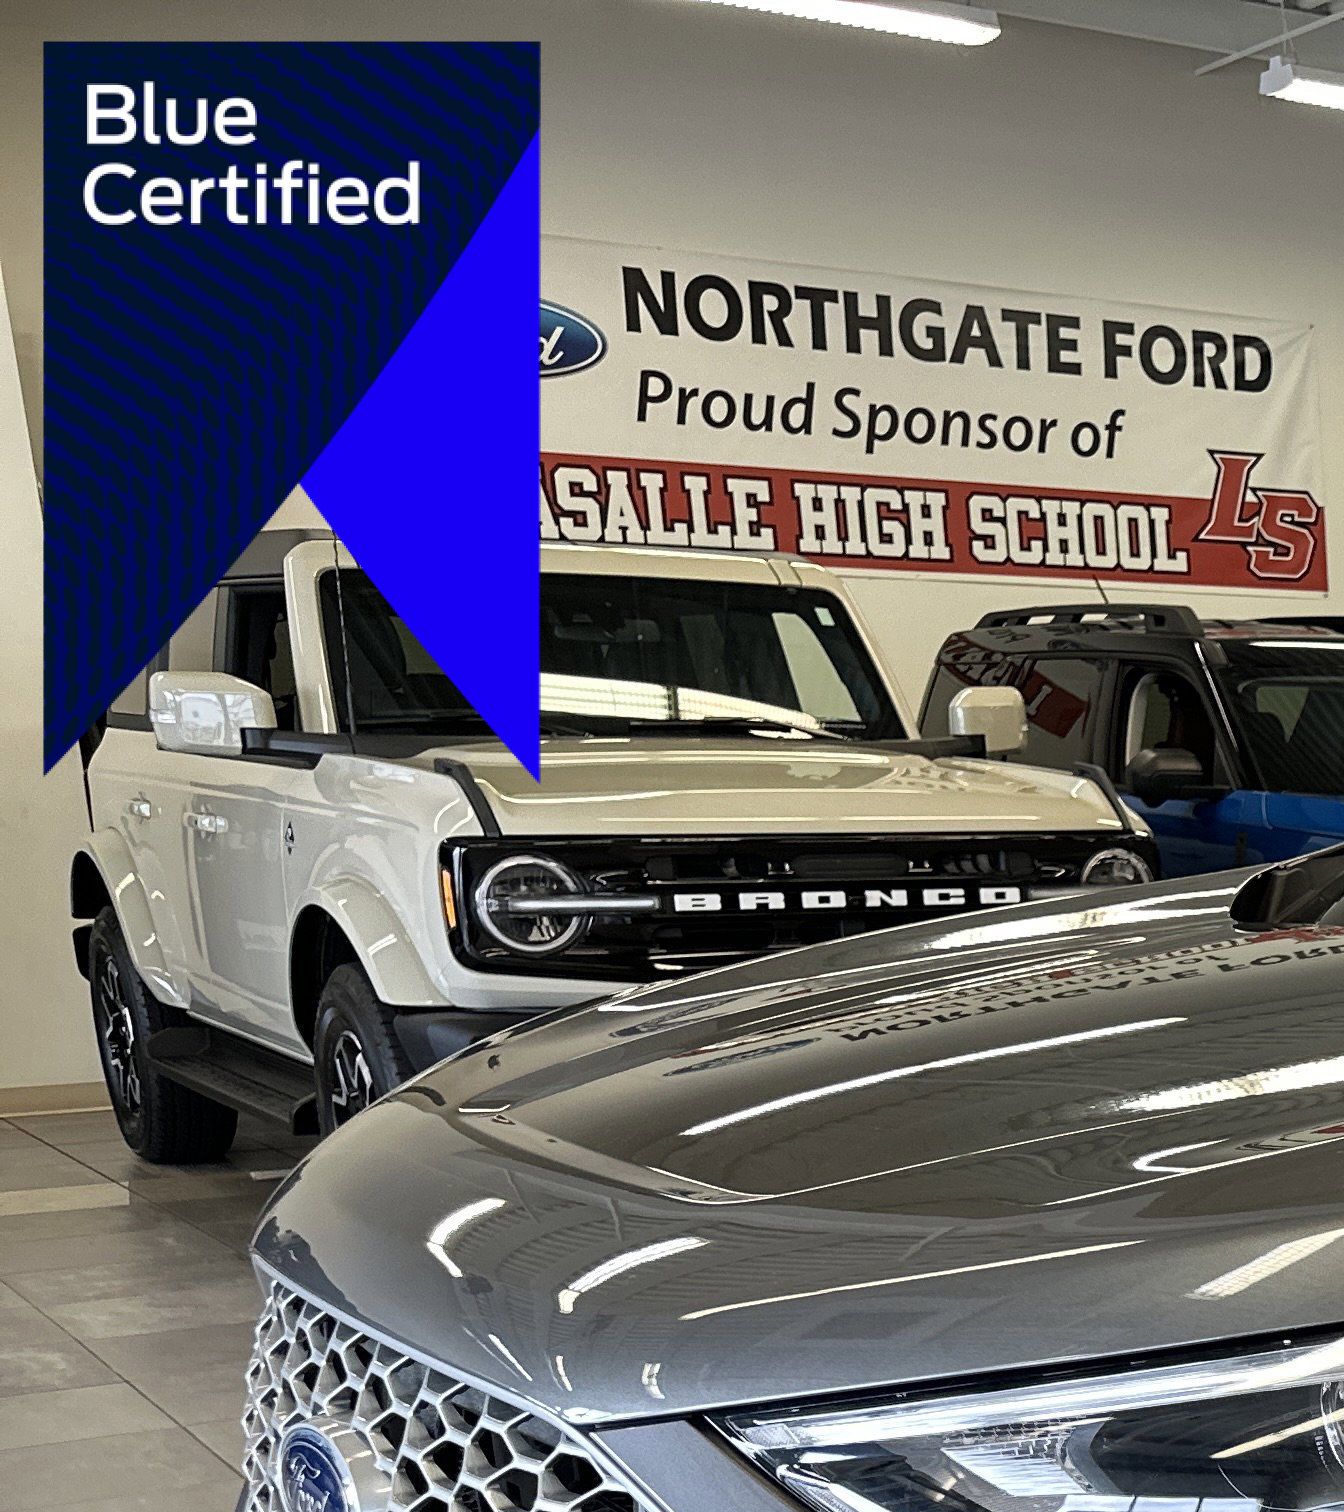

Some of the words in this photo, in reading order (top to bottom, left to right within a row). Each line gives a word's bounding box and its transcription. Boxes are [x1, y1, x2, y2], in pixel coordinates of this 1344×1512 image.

[622, 266, 1083, 376] NORTHGATE
[1103, 320, 1273, 393] FORD
[636, 370, 815, 436] Proud
[832, 386, 1058, 457] Sponsor
[1070, 409, 1126, 458] of
[792, 479, 952, 561] HIGH
[967, 494, 1190, 574] SCHOOL
[673, 887, 1021, 912] BRONCO
